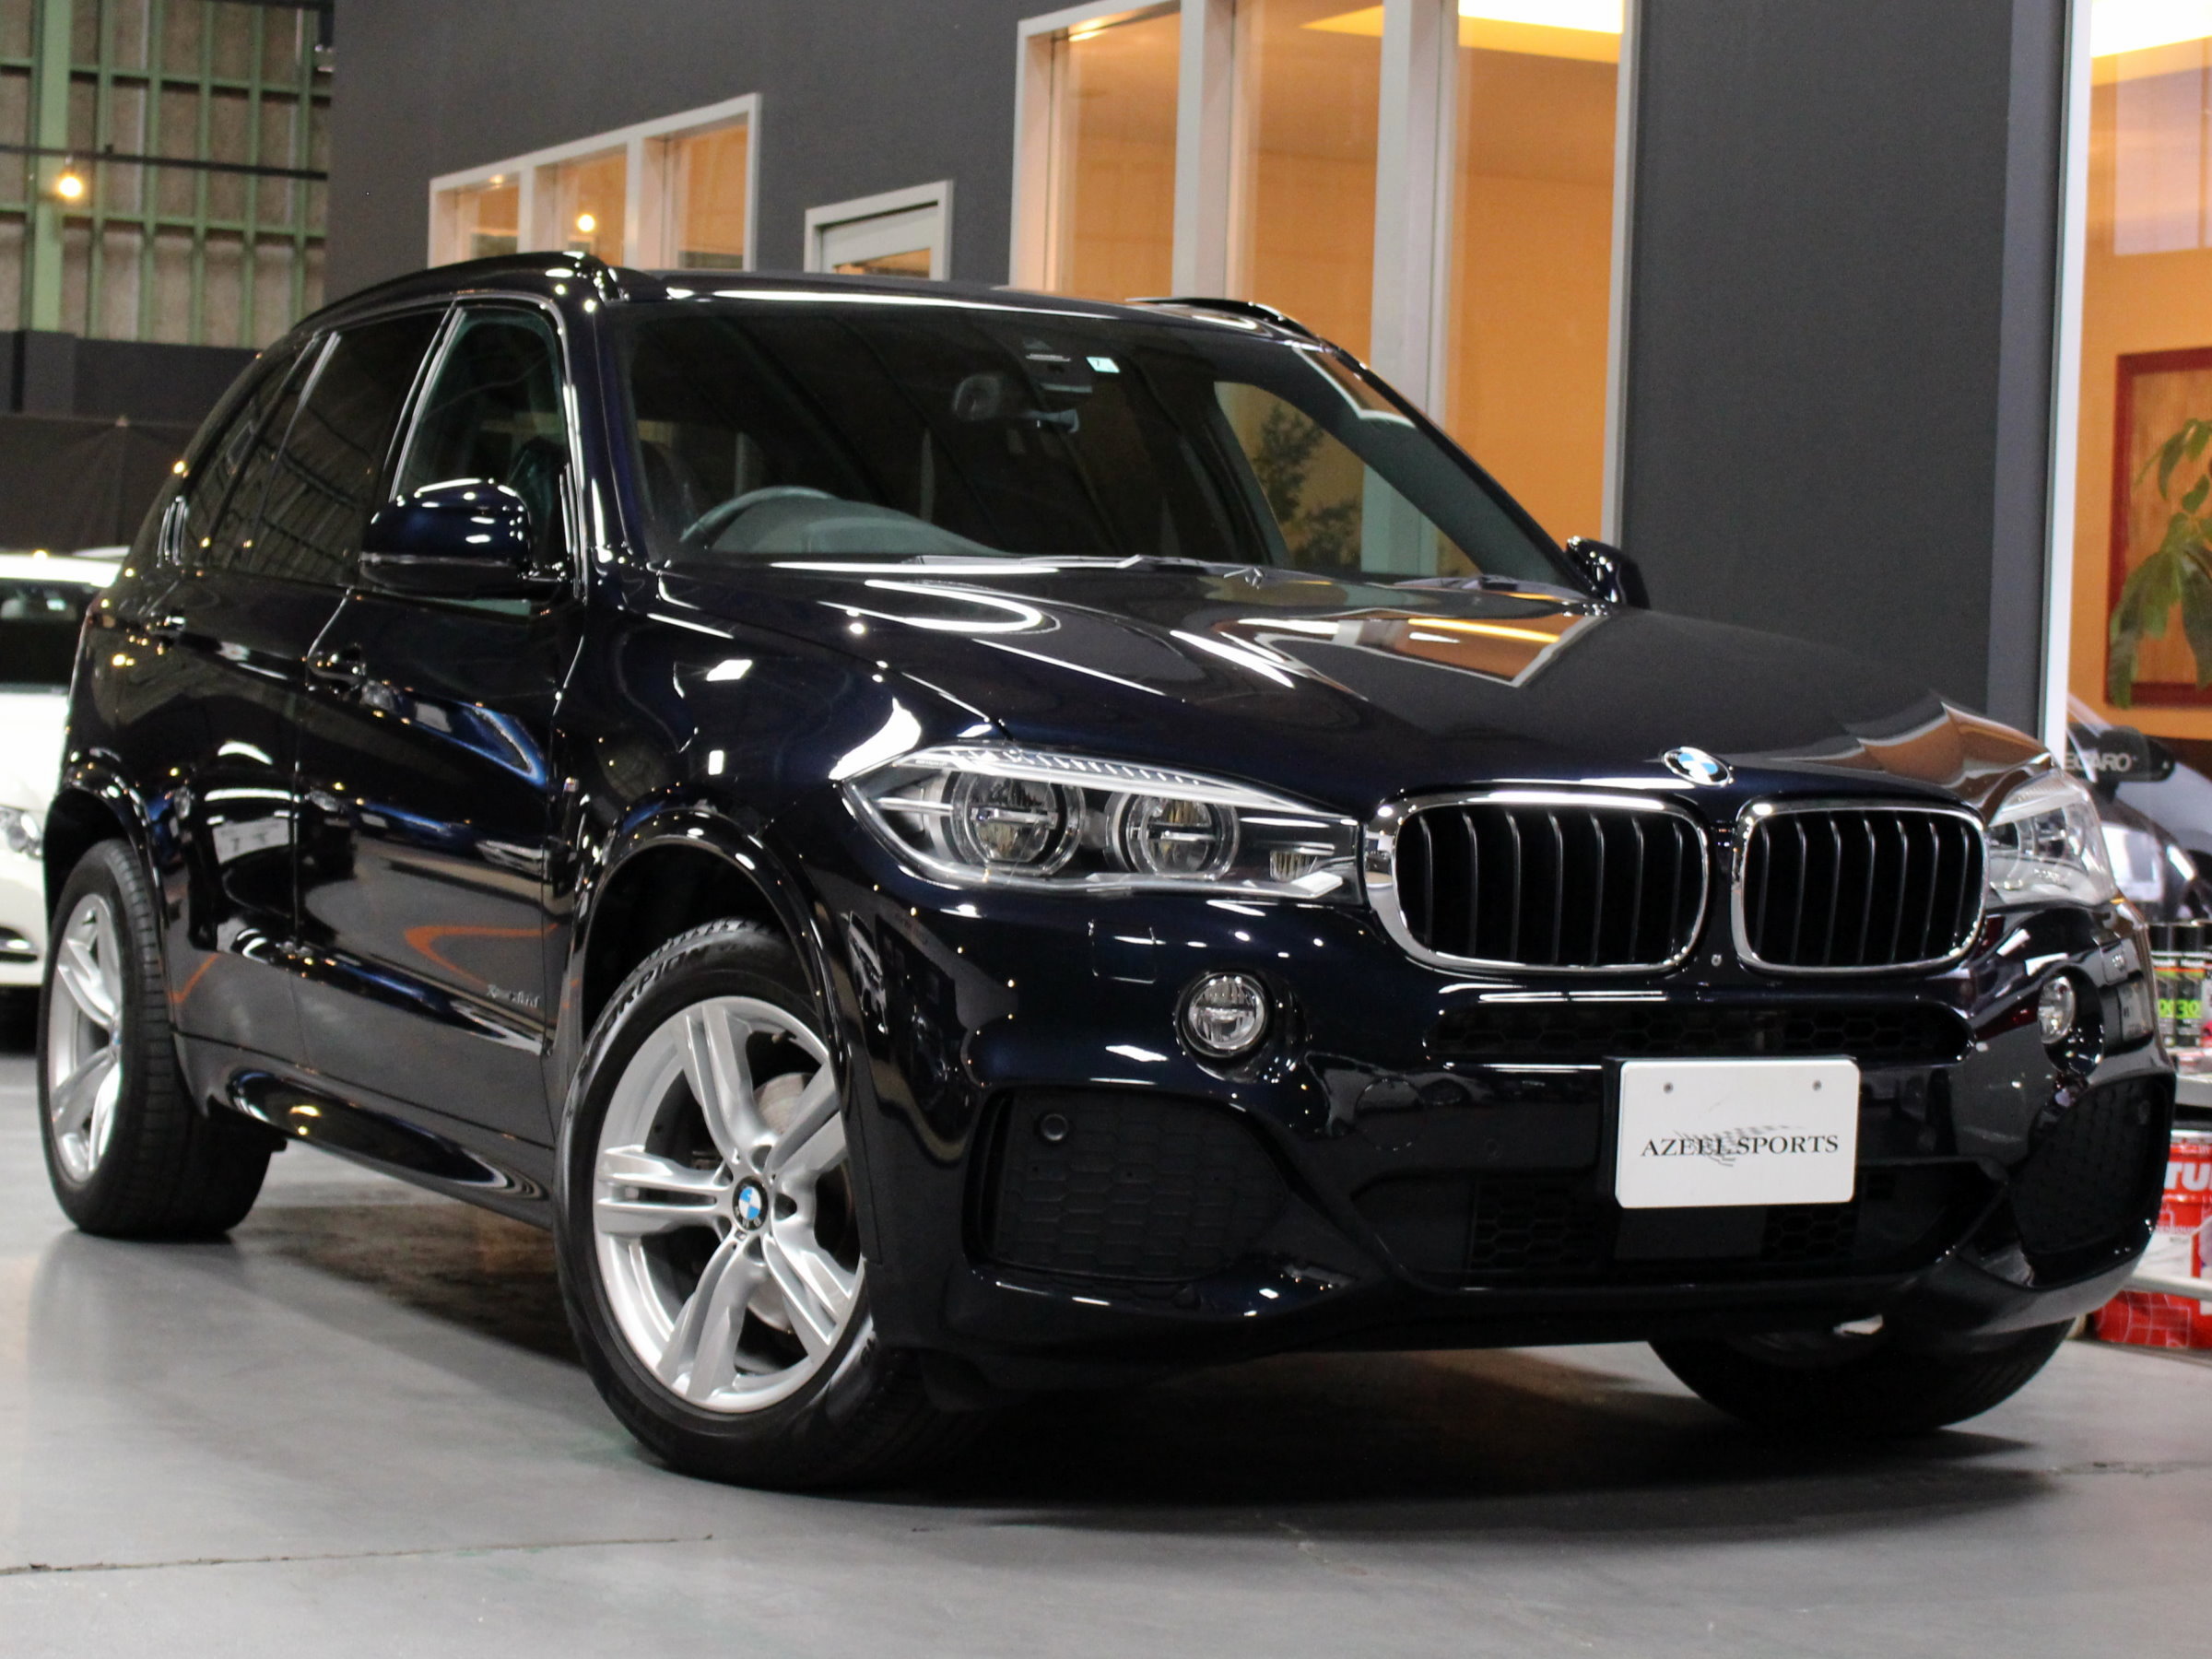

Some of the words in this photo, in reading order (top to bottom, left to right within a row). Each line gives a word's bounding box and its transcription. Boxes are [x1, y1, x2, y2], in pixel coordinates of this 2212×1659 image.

[2065, 752, 2132, 772] ECARO
[1641, 1136, 1735, 1157] AZEEL
[1736, 1135, 1839, 1156] SPORTS
